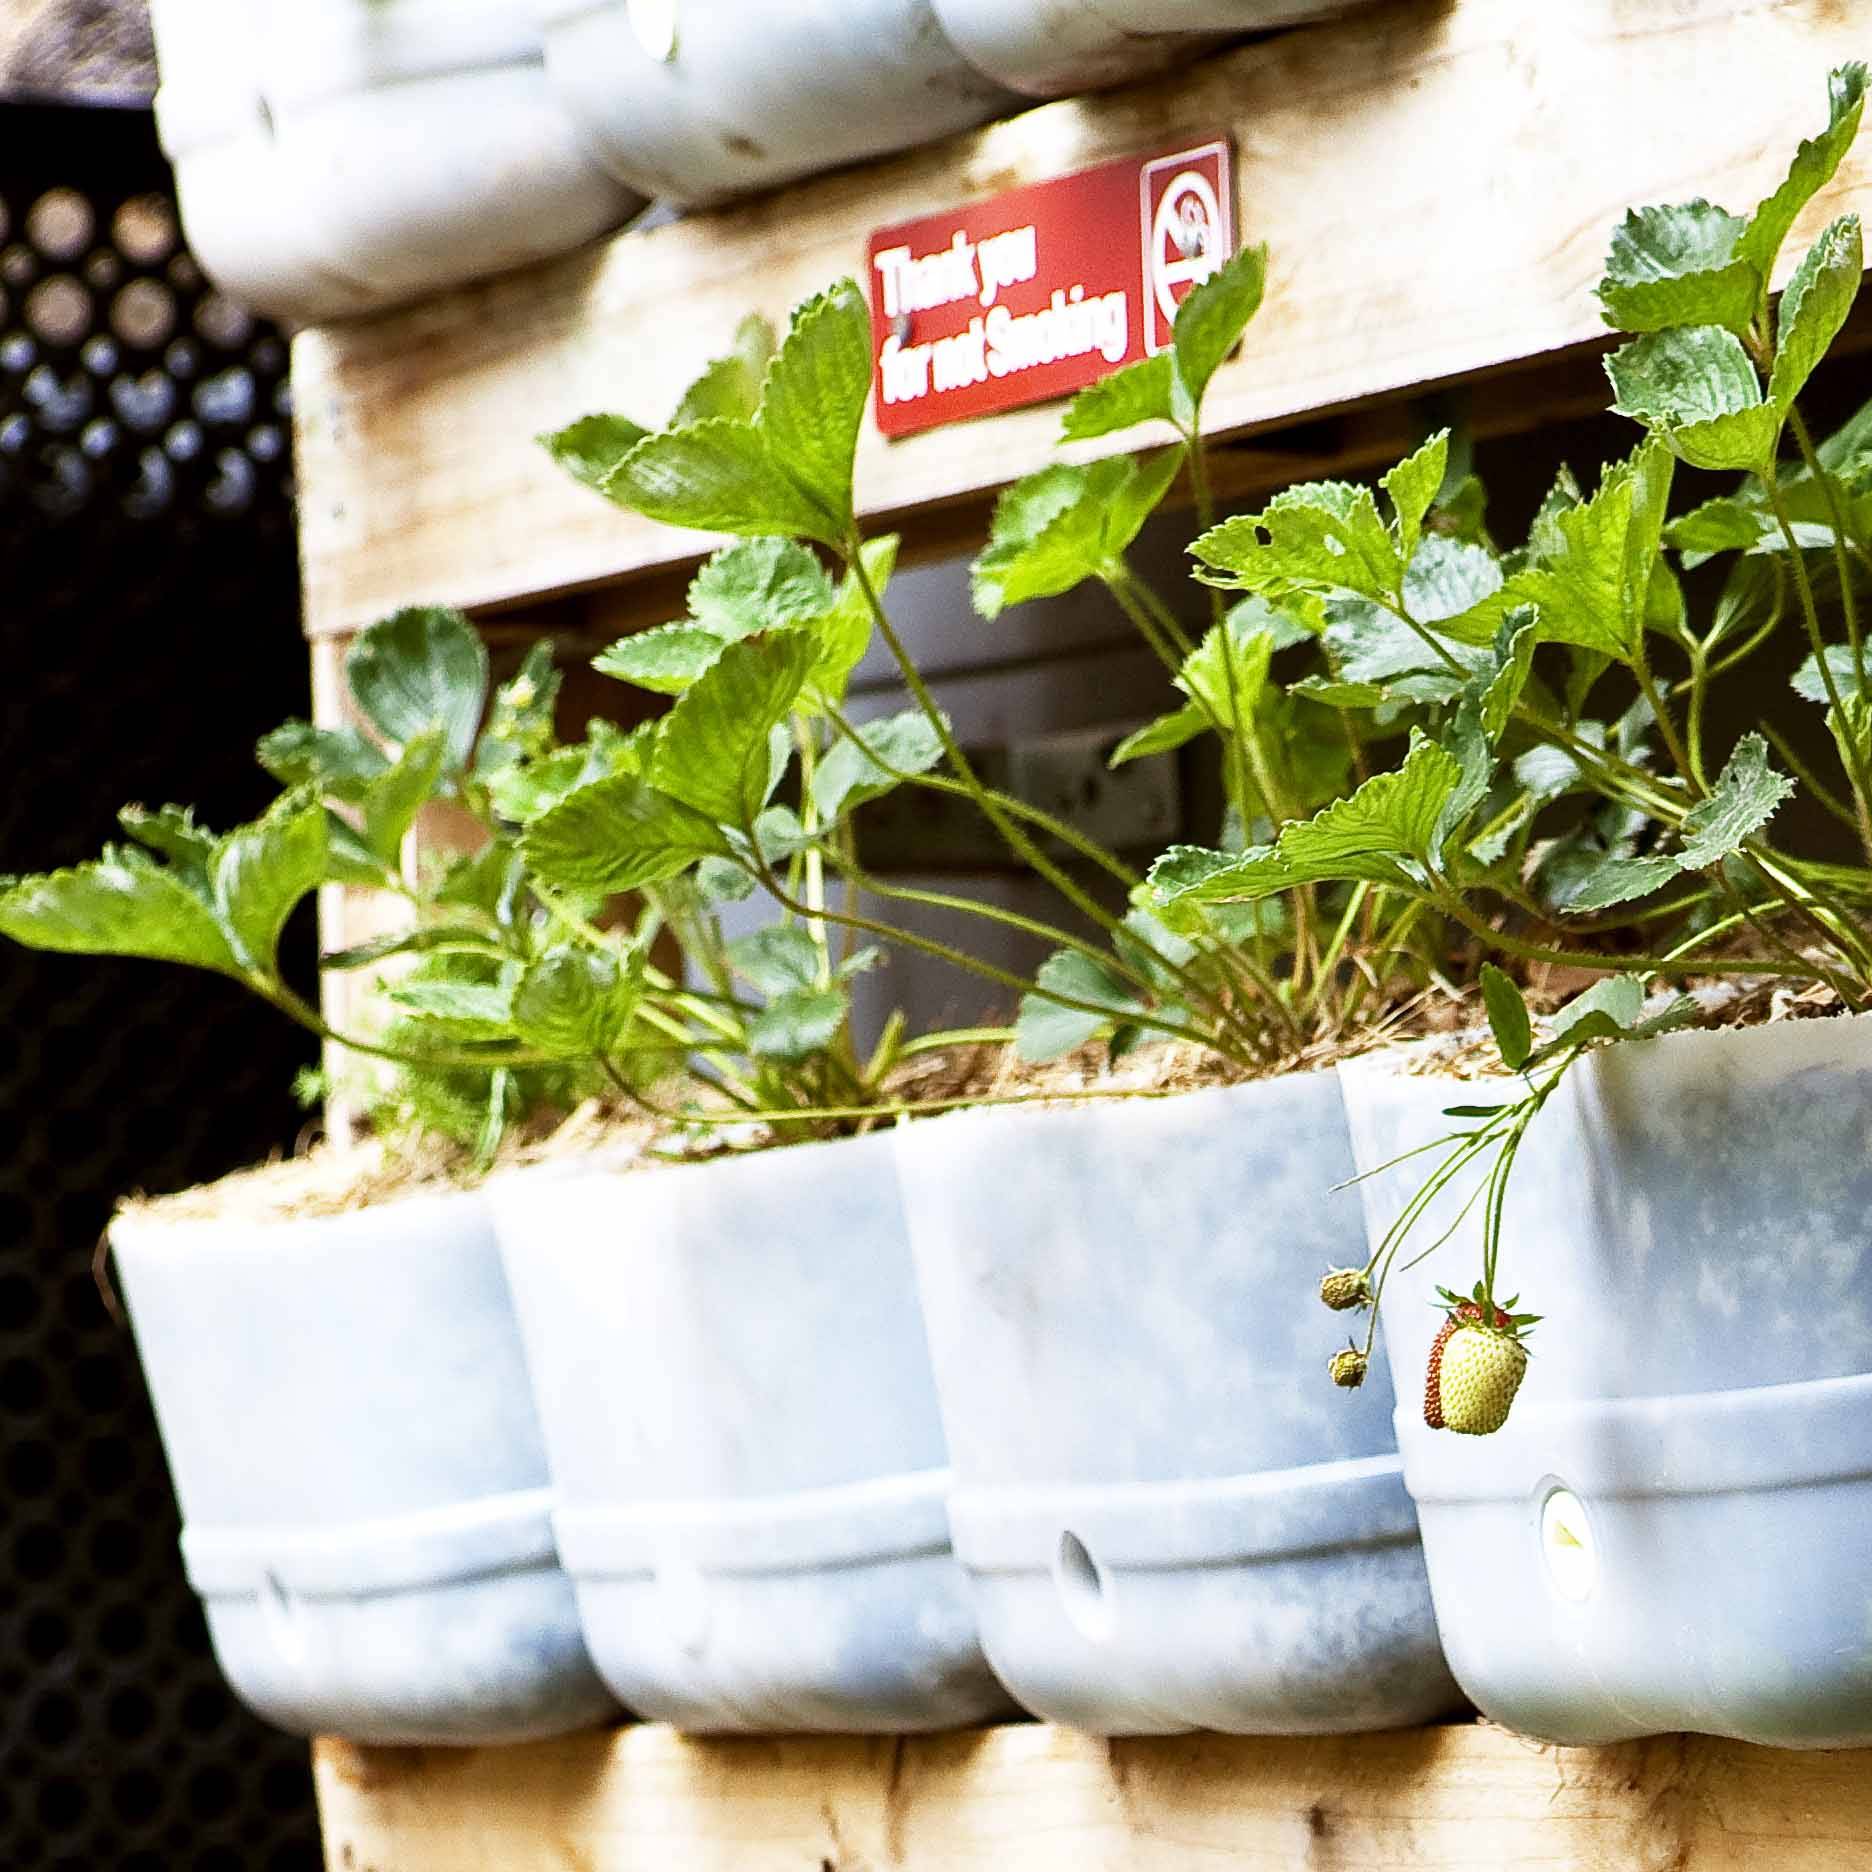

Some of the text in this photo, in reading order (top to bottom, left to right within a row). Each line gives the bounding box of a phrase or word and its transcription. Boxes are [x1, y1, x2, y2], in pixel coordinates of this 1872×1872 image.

[874, 224, 1037, 318] Thank you
[880, 285, 1128, 404] for not Smoking
